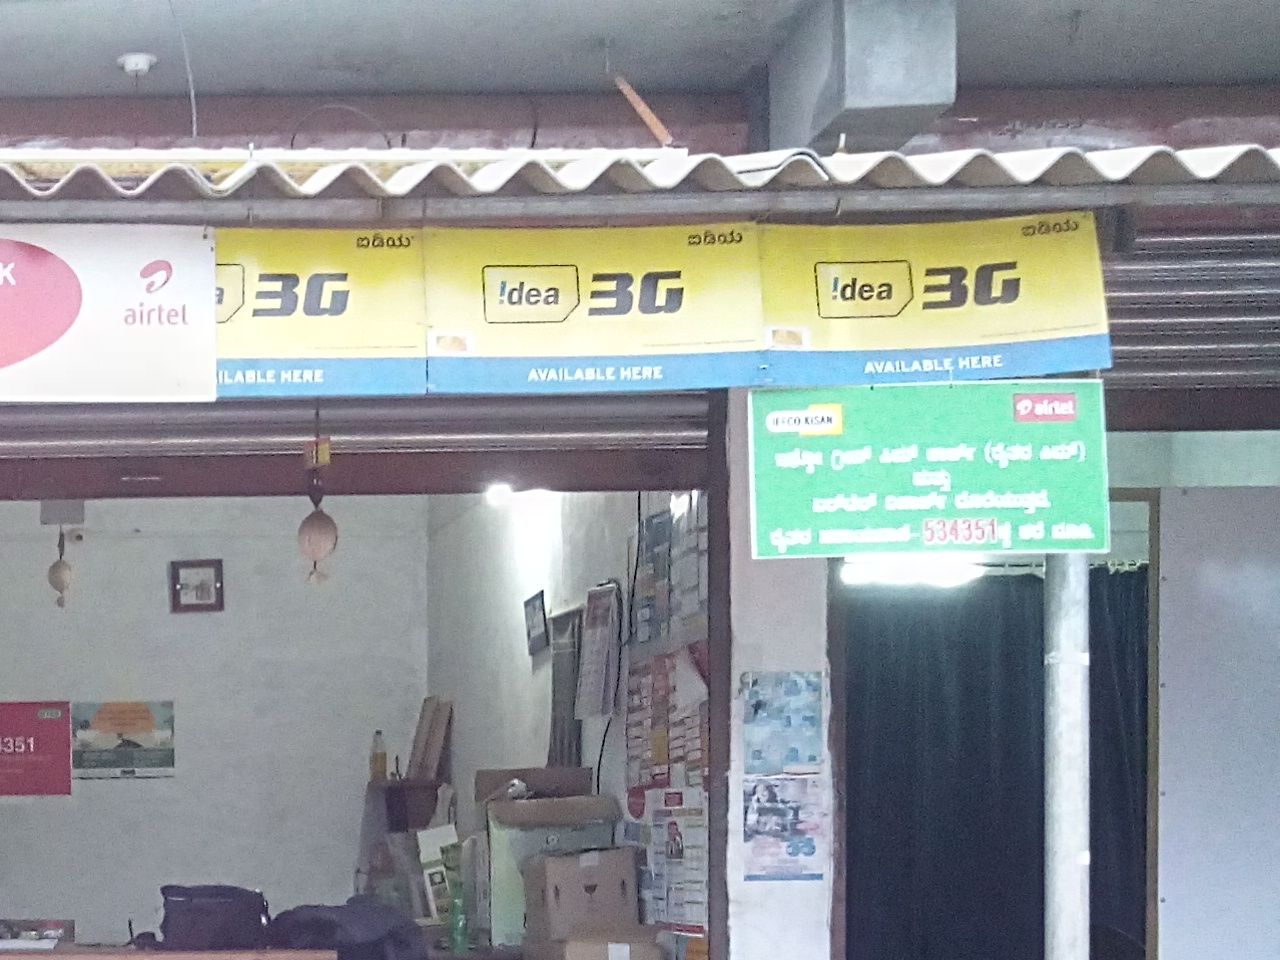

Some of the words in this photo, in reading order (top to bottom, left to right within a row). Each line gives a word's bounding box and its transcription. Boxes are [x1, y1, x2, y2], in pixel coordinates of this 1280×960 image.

[252, 273, 350, 317] 3G
[588, 270, 685, 317] 3G
[922, 261, 1021, 311] 3G
[123, 302, 189, 327] airtel
[218, 370, 276, 383] ILABLE
[280, 369, 324, 383] HERE
[527, 367, 616, 382] AVAILABLE
[620, 366, 663, 380] HERE
[864, 358, 954, 374] AVAILABLE
[958, 354, 1003, 370] HERE
[925, 518, 997, 542] 534351
